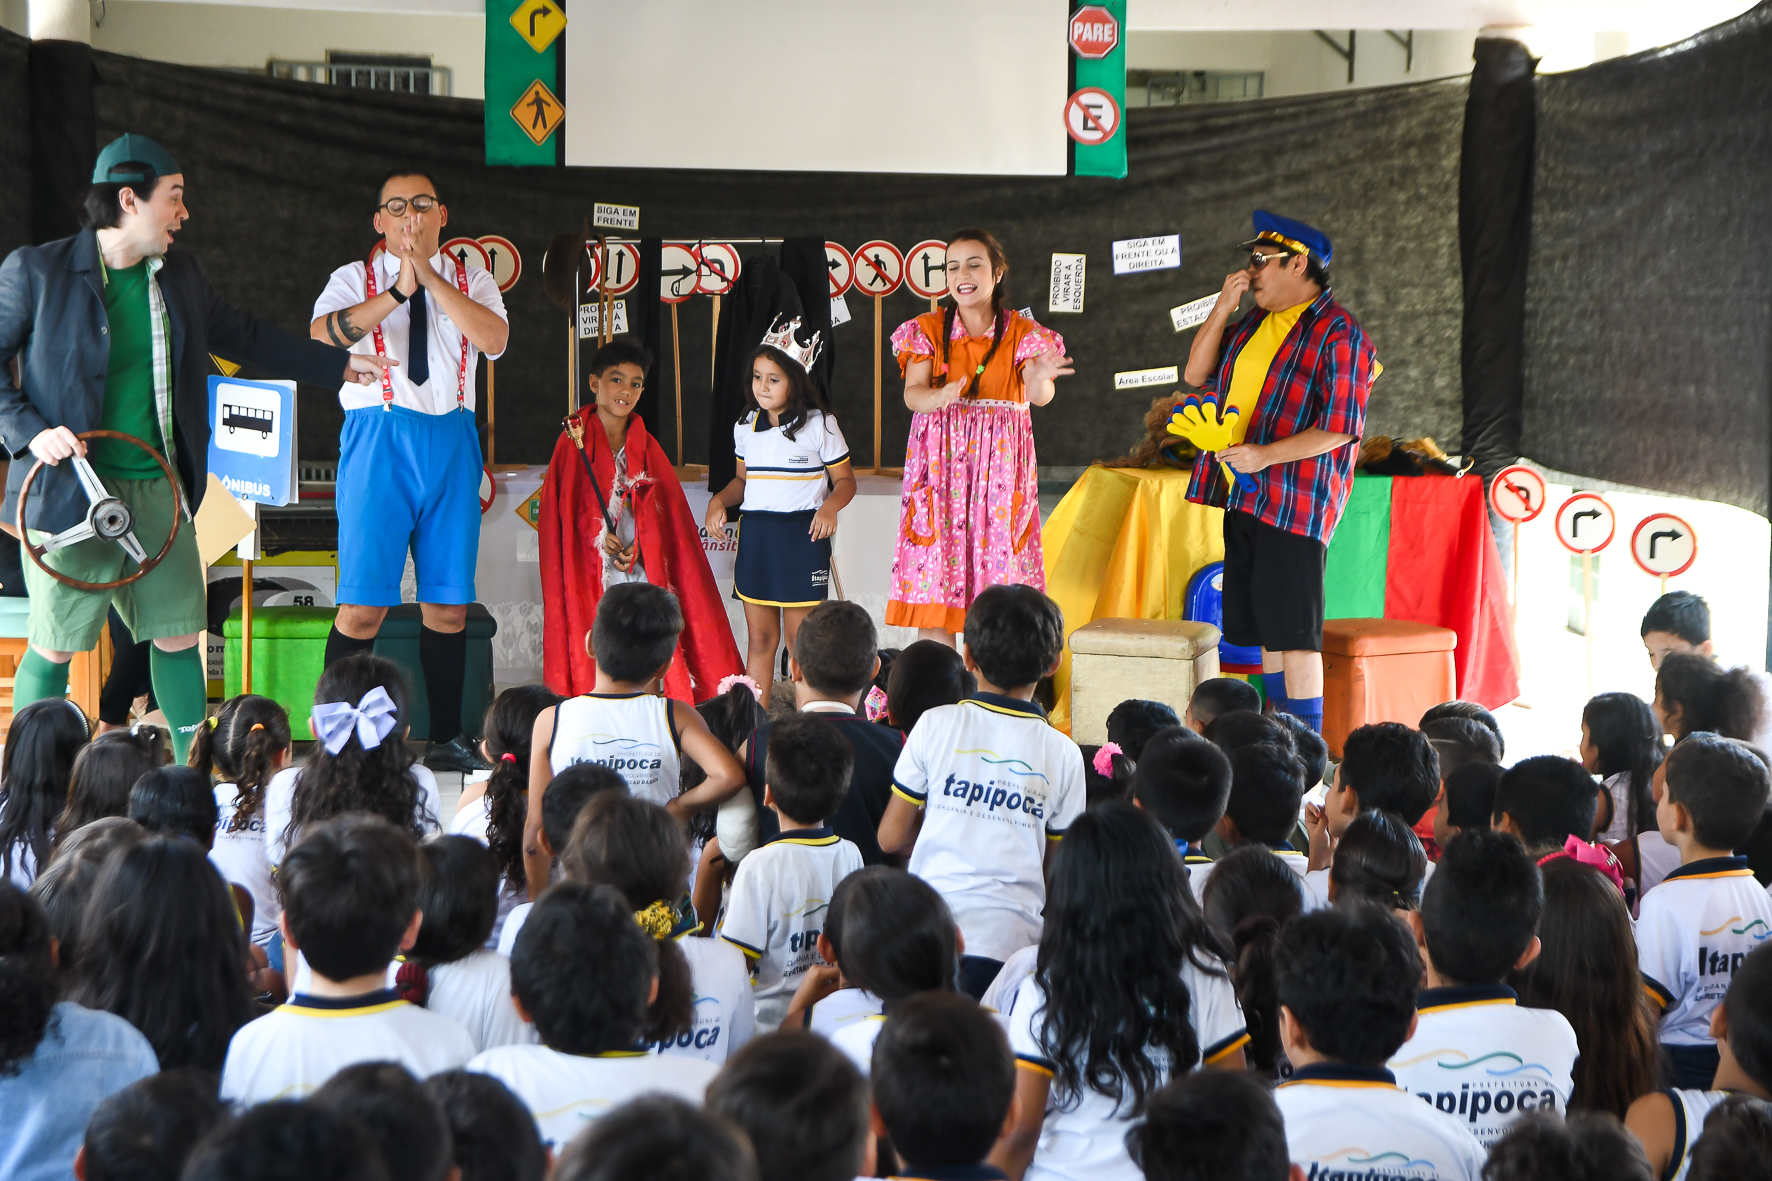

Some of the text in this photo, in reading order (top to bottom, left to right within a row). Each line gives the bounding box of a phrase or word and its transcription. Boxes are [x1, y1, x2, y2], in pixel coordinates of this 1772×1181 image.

[1073, 21, 1114, 42] PARE
[1083, 103, 1103, 130] E
[597, 205, 637, 217] SIGA EM
[597, 216, 634, 227] FRENTE
[1127, 238, 1165, 249] SIGA EM
[1115, 250, 1152, 261] FRENTE
[1154, 247, 1168, 256] OU
[1128, 259, 1165, 270] DIREITA
[1052, 259, 1062, 305] PROIBIDO
[1062, 273, 1072, 303] VIRAR
[1073, 256, 1084, 310] ESQUERDA
[1180, 296, 1220, 316] PROIBID
[1141, 373, 1175, 383] Escolar
[221, 474, 272, 498] ÔNIBUS
[293, 596, 315, 607] 58
[943, 772, 1044, 820] tapipoca
